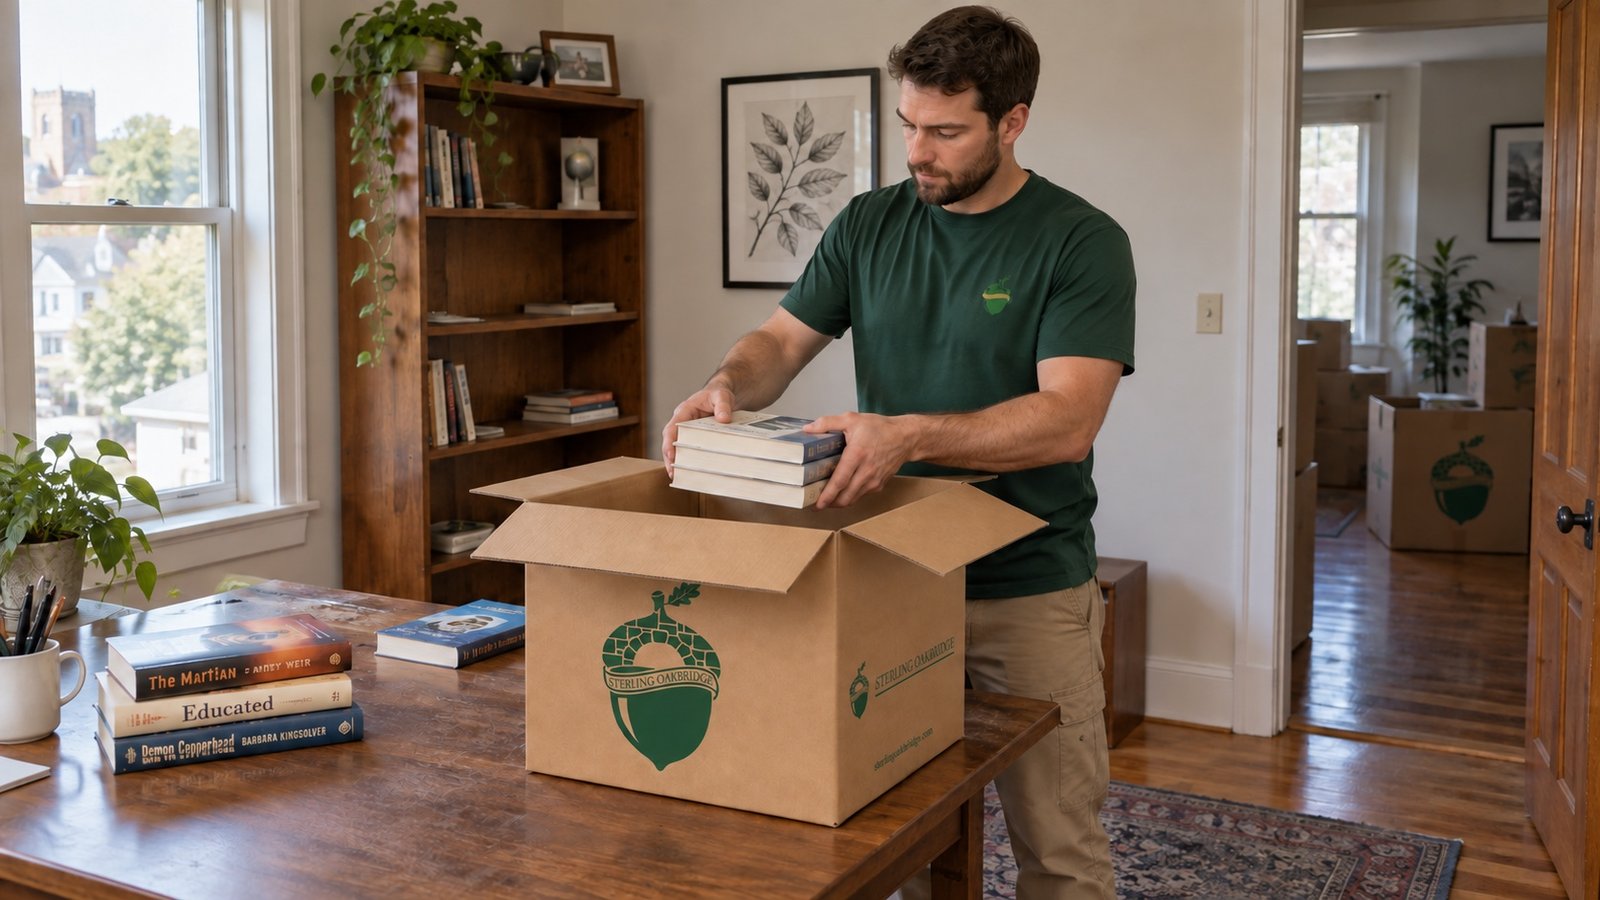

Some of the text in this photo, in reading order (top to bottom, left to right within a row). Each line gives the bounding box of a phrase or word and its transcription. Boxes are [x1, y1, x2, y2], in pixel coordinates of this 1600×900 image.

[286, 658, 311, 669] WEIR
[149, 675, 176, 690] The
[608, 671, 713, 689] STERLING OAKBRIDGE
[182, 695, 274, 722] Educated
[241, 726, 327, 746] BARBARA KINGSOLVER
[142, 744, 175, 757] Demon
